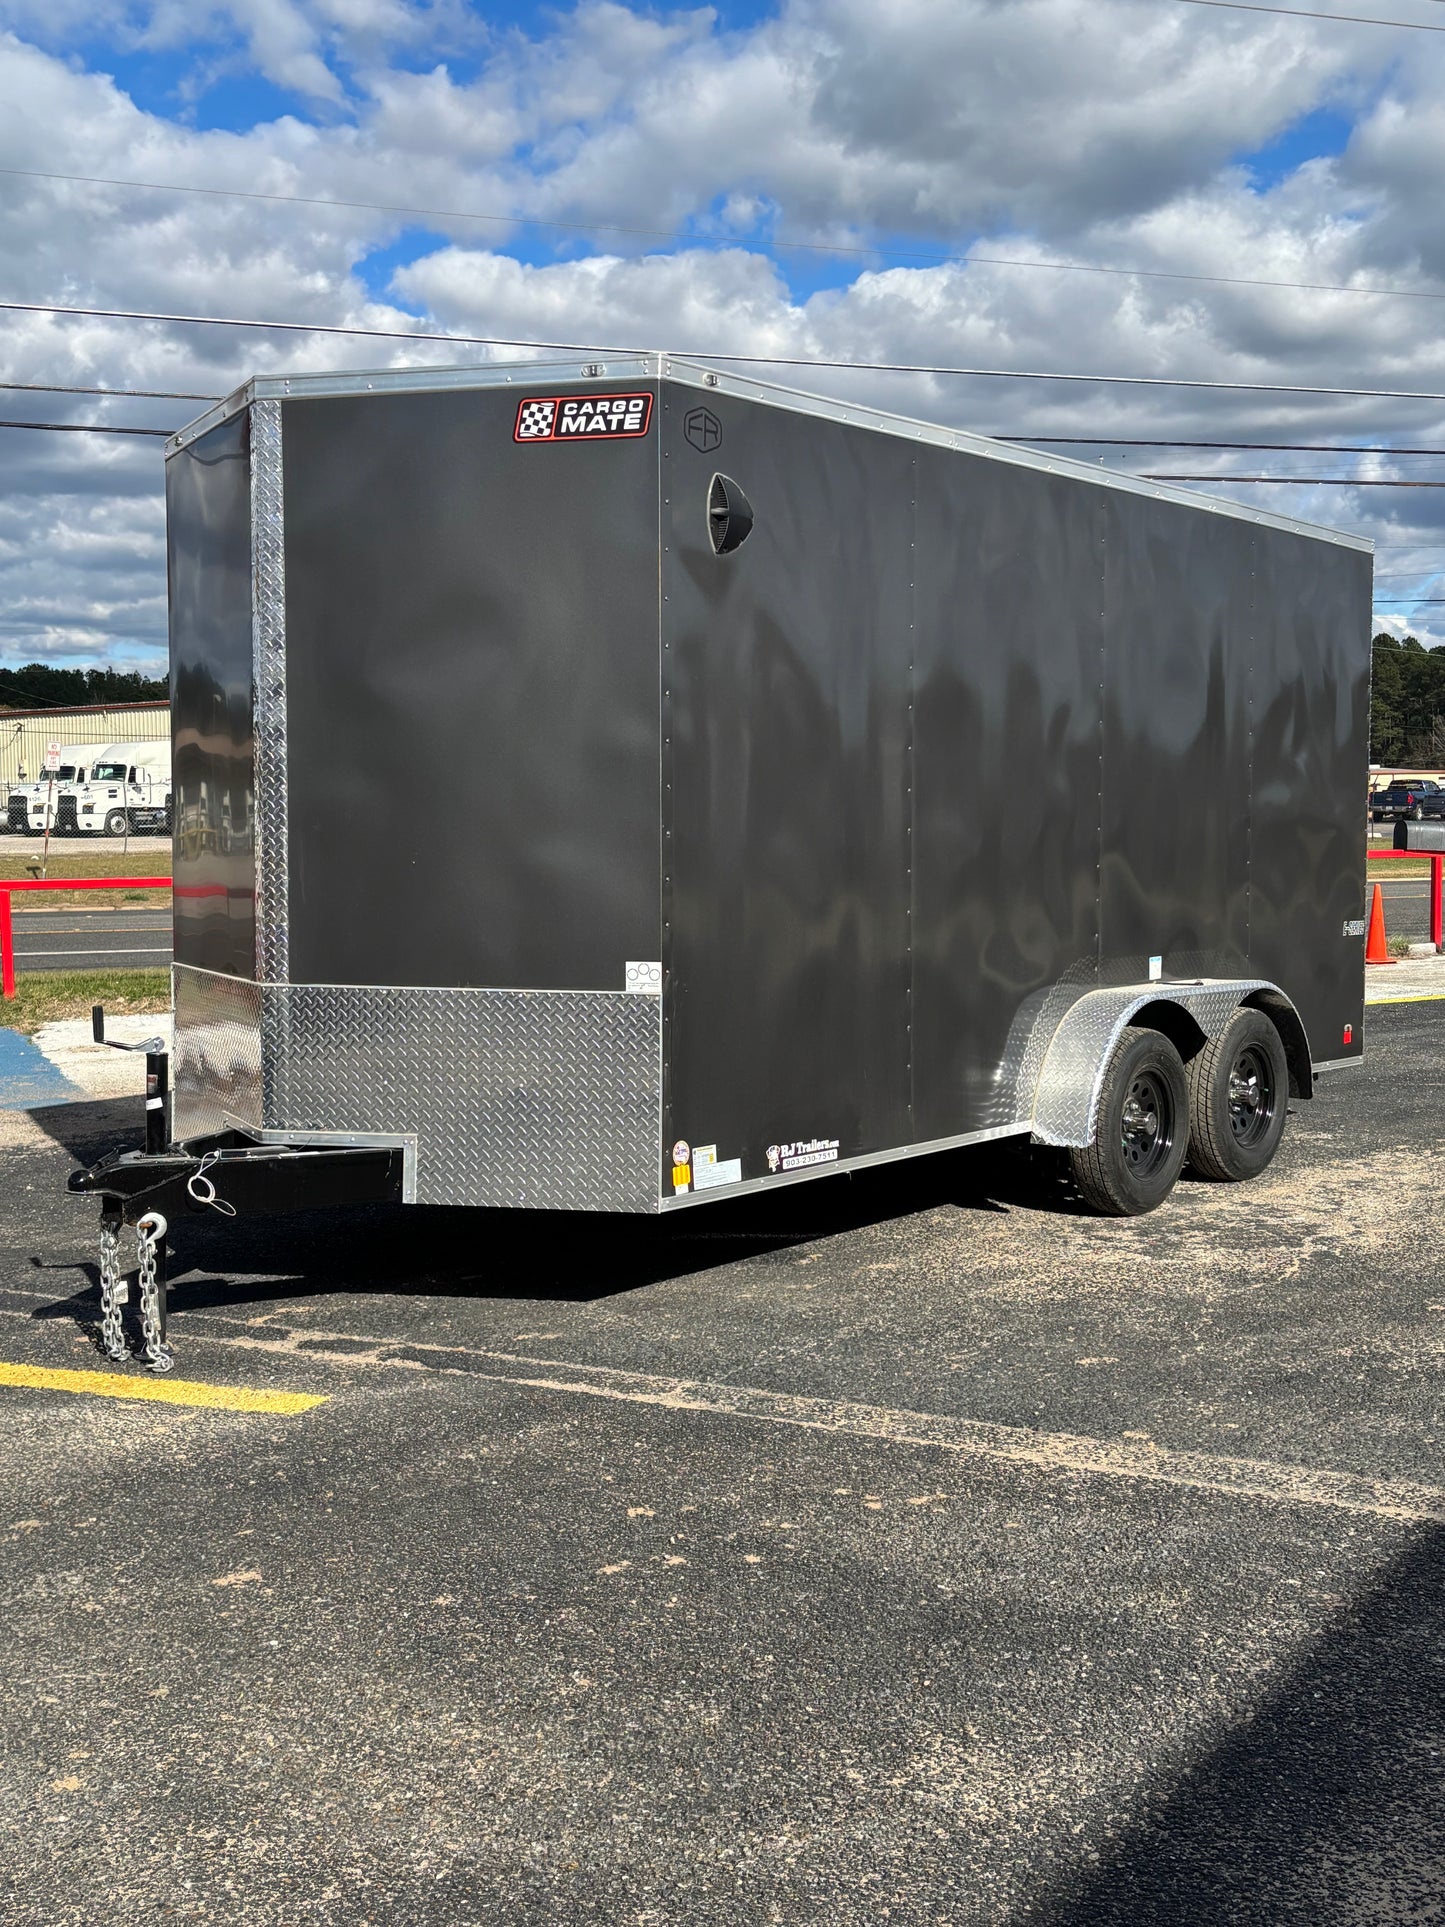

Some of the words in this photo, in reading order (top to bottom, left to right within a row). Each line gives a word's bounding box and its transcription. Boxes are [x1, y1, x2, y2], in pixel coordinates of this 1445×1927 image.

[563, 399, 644, 416] CARGO
[560, 413, 642, 433] MATE
[785, 1151, 836, 1167] 903-230-7511
